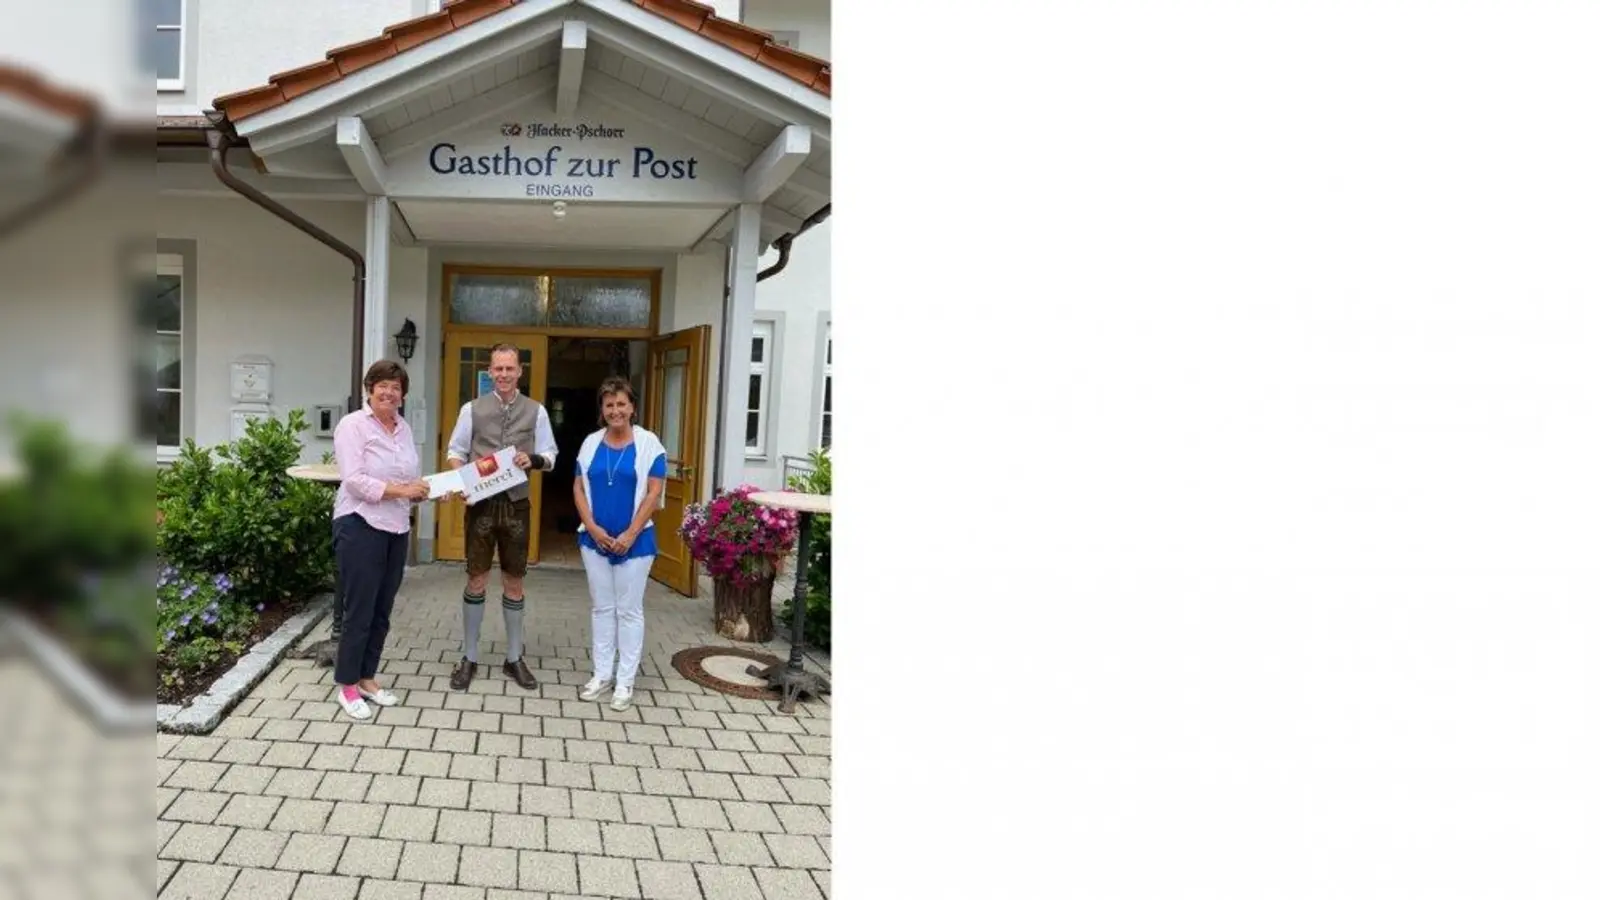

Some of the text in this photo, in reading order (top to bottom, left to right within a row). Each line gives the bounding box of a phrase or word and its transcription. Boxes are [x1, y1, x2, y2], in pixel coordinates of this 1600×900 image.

[527, 123, 625, 140] Hacker-Pschorr
[429, 143, 698, 179] Gasthof zur Post
[526, 184, 594, 197] EINGANG
[474, 468, 514, 493] merci
